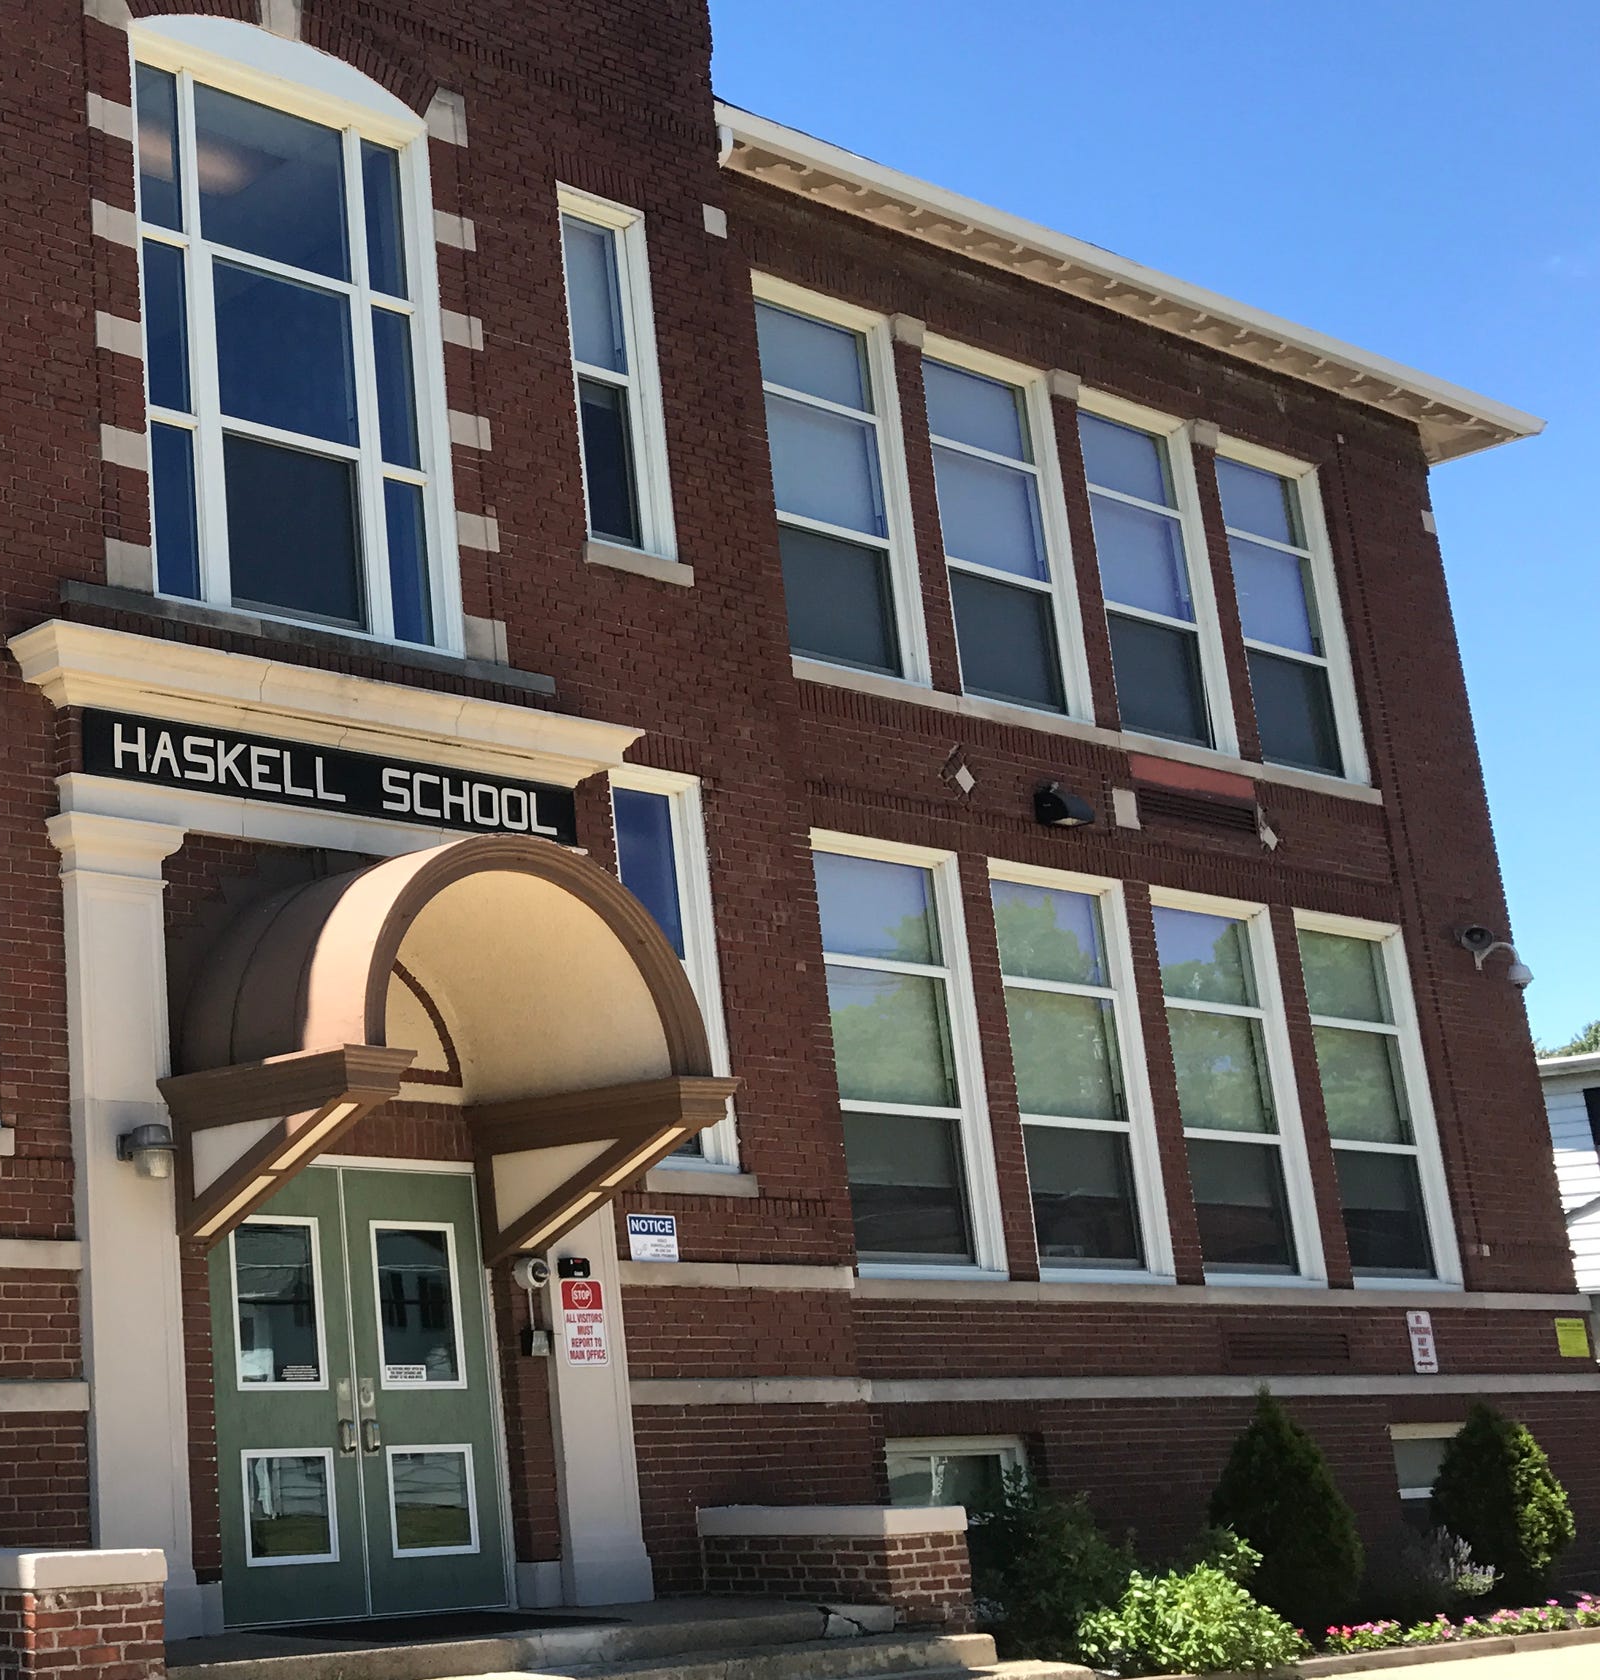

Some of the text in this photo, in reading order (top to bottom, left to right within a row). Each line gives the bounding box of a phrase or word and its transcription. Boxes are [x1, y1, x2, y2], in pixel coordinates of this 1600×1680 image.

[112, 722, 559, 836] HASKELL SCHOOL
[630, 1219, 673, 1233] NOTICE
[573, 1290, 590, 1300] STOP
[566, 1313, 603, 1323] ALL VISITORS
[577, 1325, 593, 1336] MUST
[571, 1337, 602, 1348] REPORT TO
[569, 1349, 606, 1360] MAIN OFFICE
